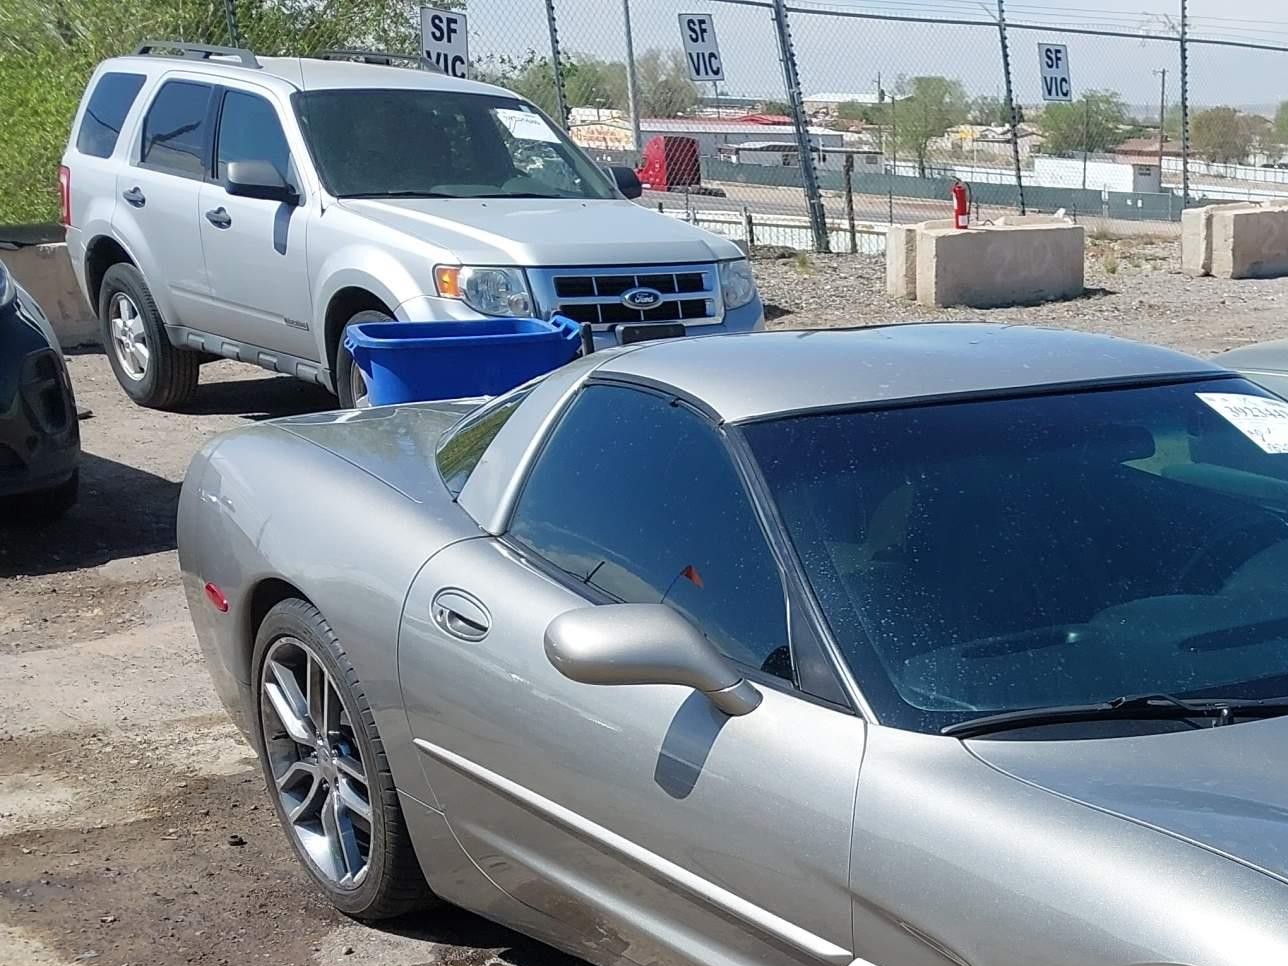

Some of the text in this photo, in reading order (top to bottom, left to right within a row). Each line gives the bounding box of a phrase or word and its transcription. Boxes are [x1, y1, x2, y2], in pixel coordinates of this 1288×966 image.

[431, 14, 458, 43] SF
[687, 18, 708, 43] SF
[688, 52, 720, 76] VIC
[1044, 48, 1062, 69] SF
[1044, 76, 1069, 97] VIC
[634, 292, 654, 303] Ford
